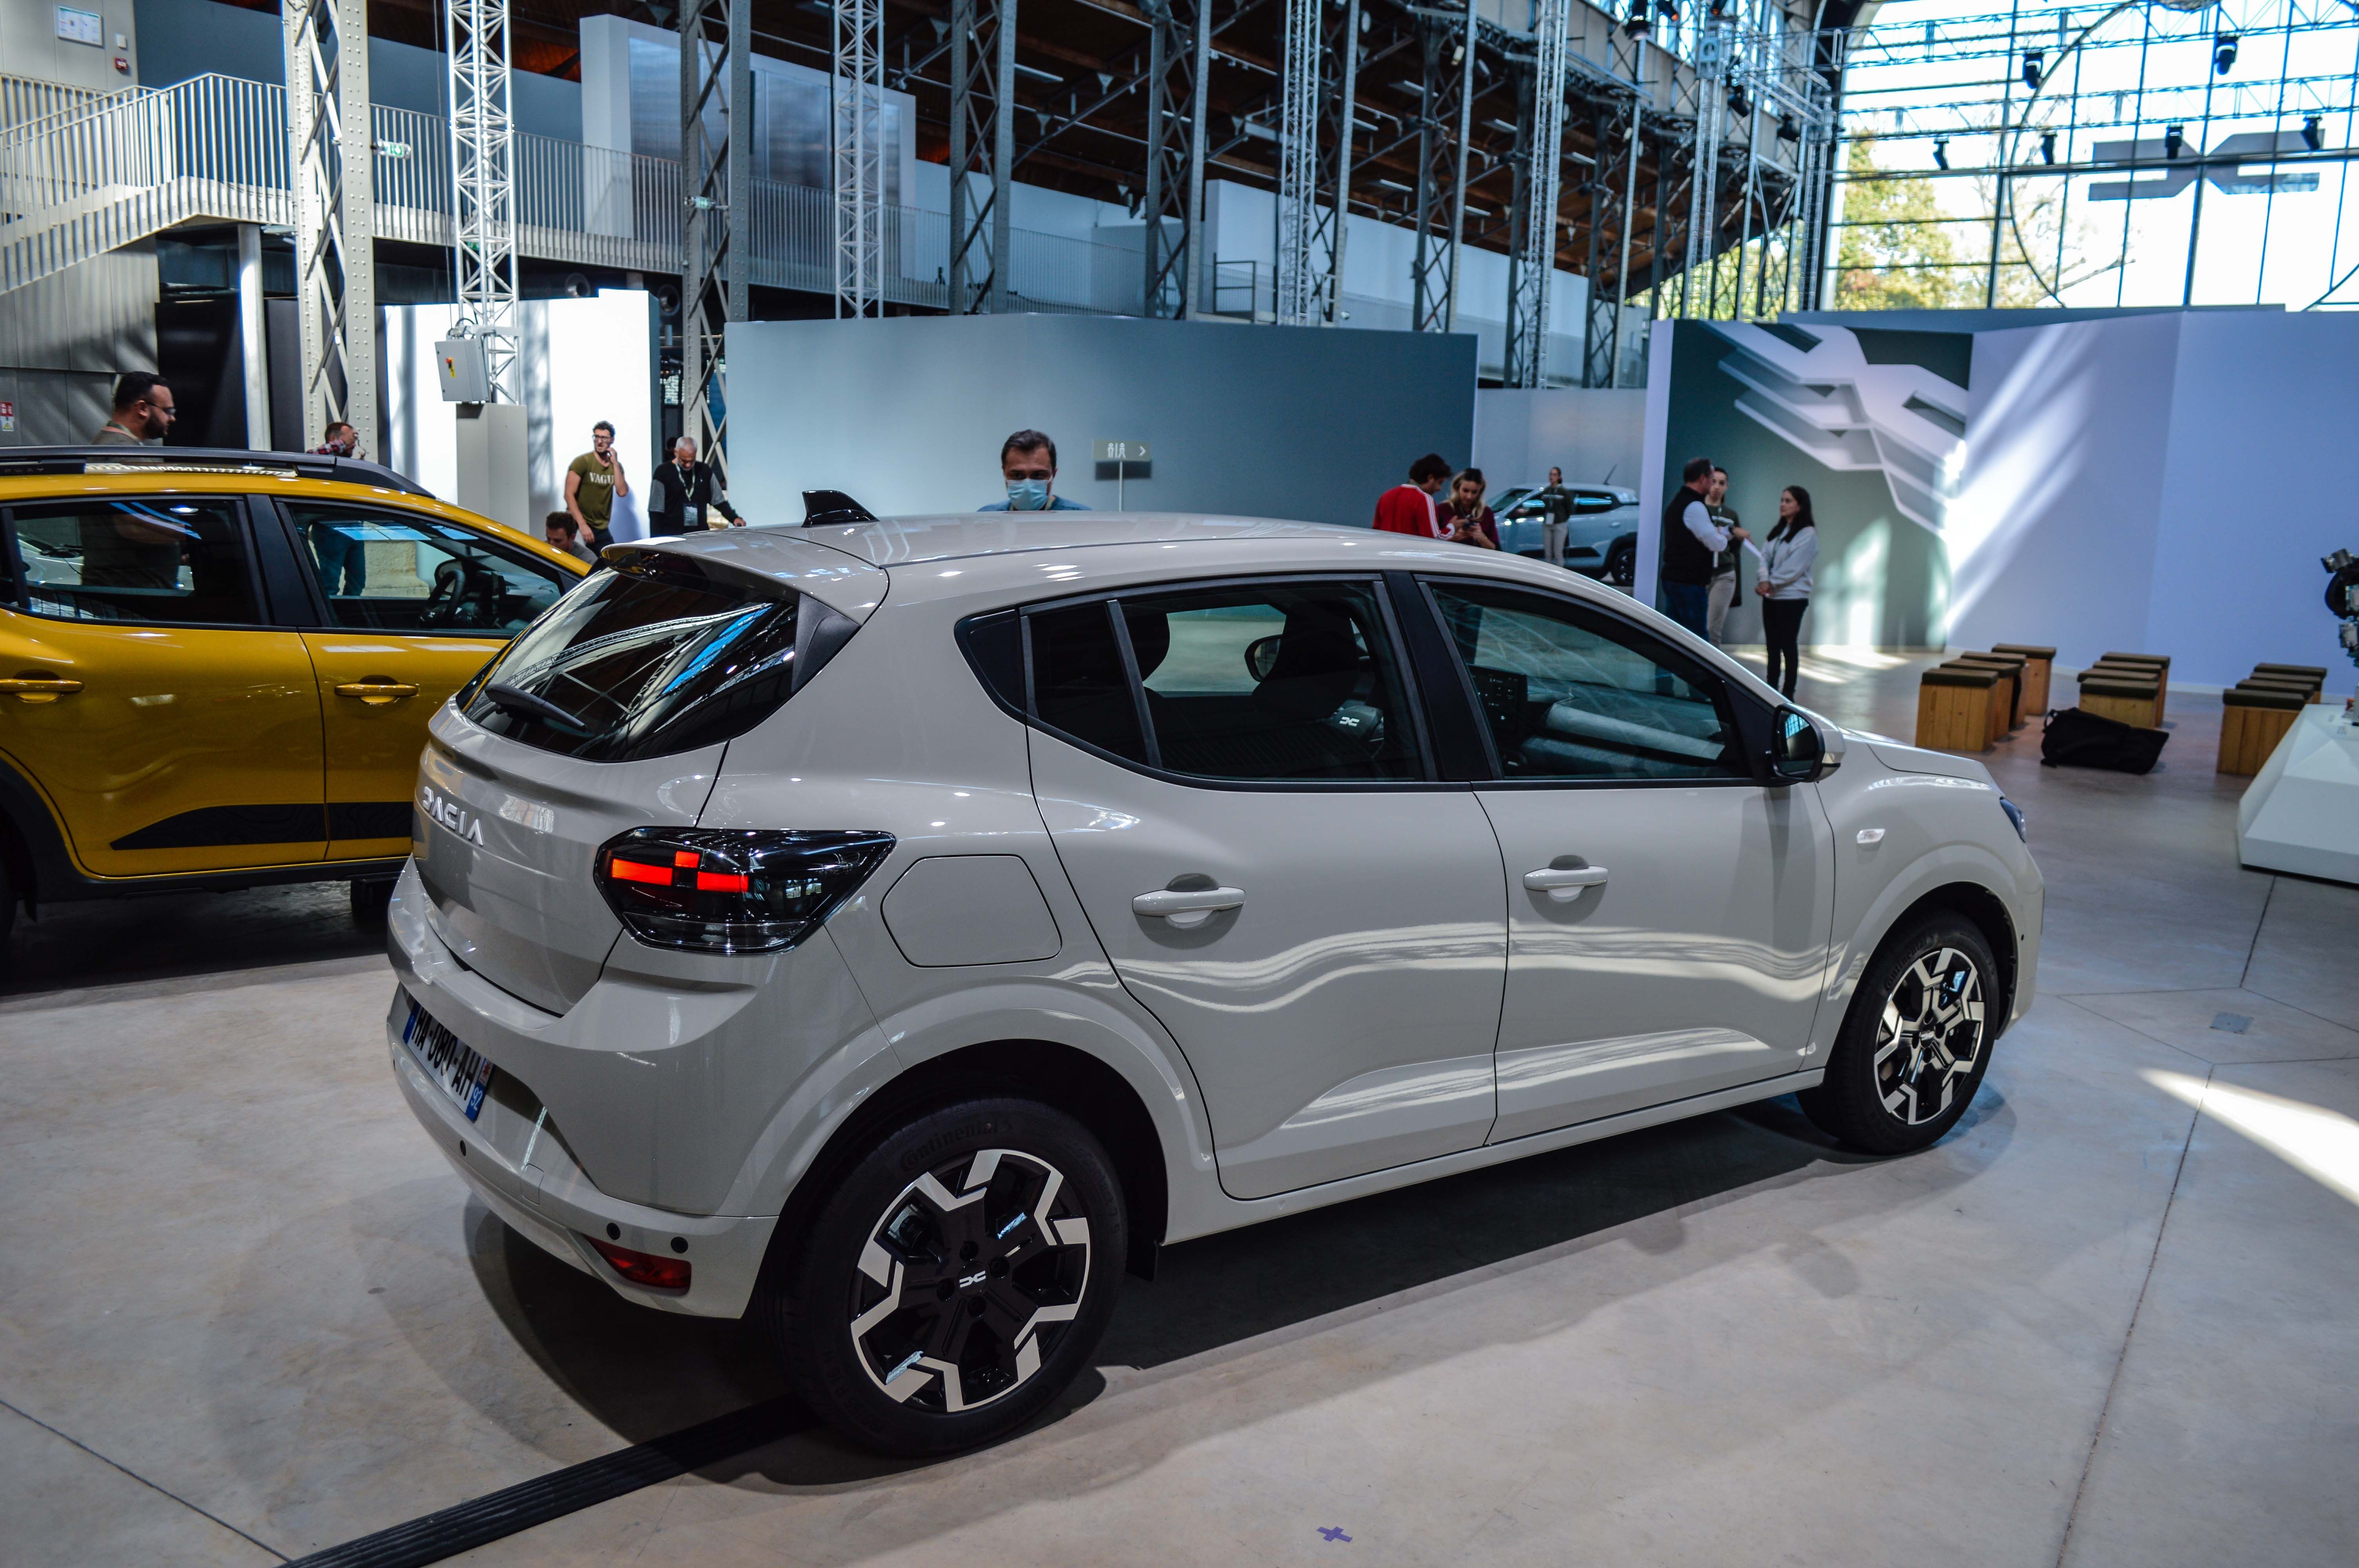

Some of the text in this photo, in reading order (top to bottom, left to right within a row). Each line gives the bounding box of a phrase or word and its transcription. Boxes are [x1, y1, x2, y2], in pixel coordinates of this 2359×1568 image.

[589, 472, 614, 484] VAGU
[422, 786, 484, 846] DACIA
[411, 1007, 483, 1111] HA-080-AH 92
[900, 1121, 998, 1172] Continental
